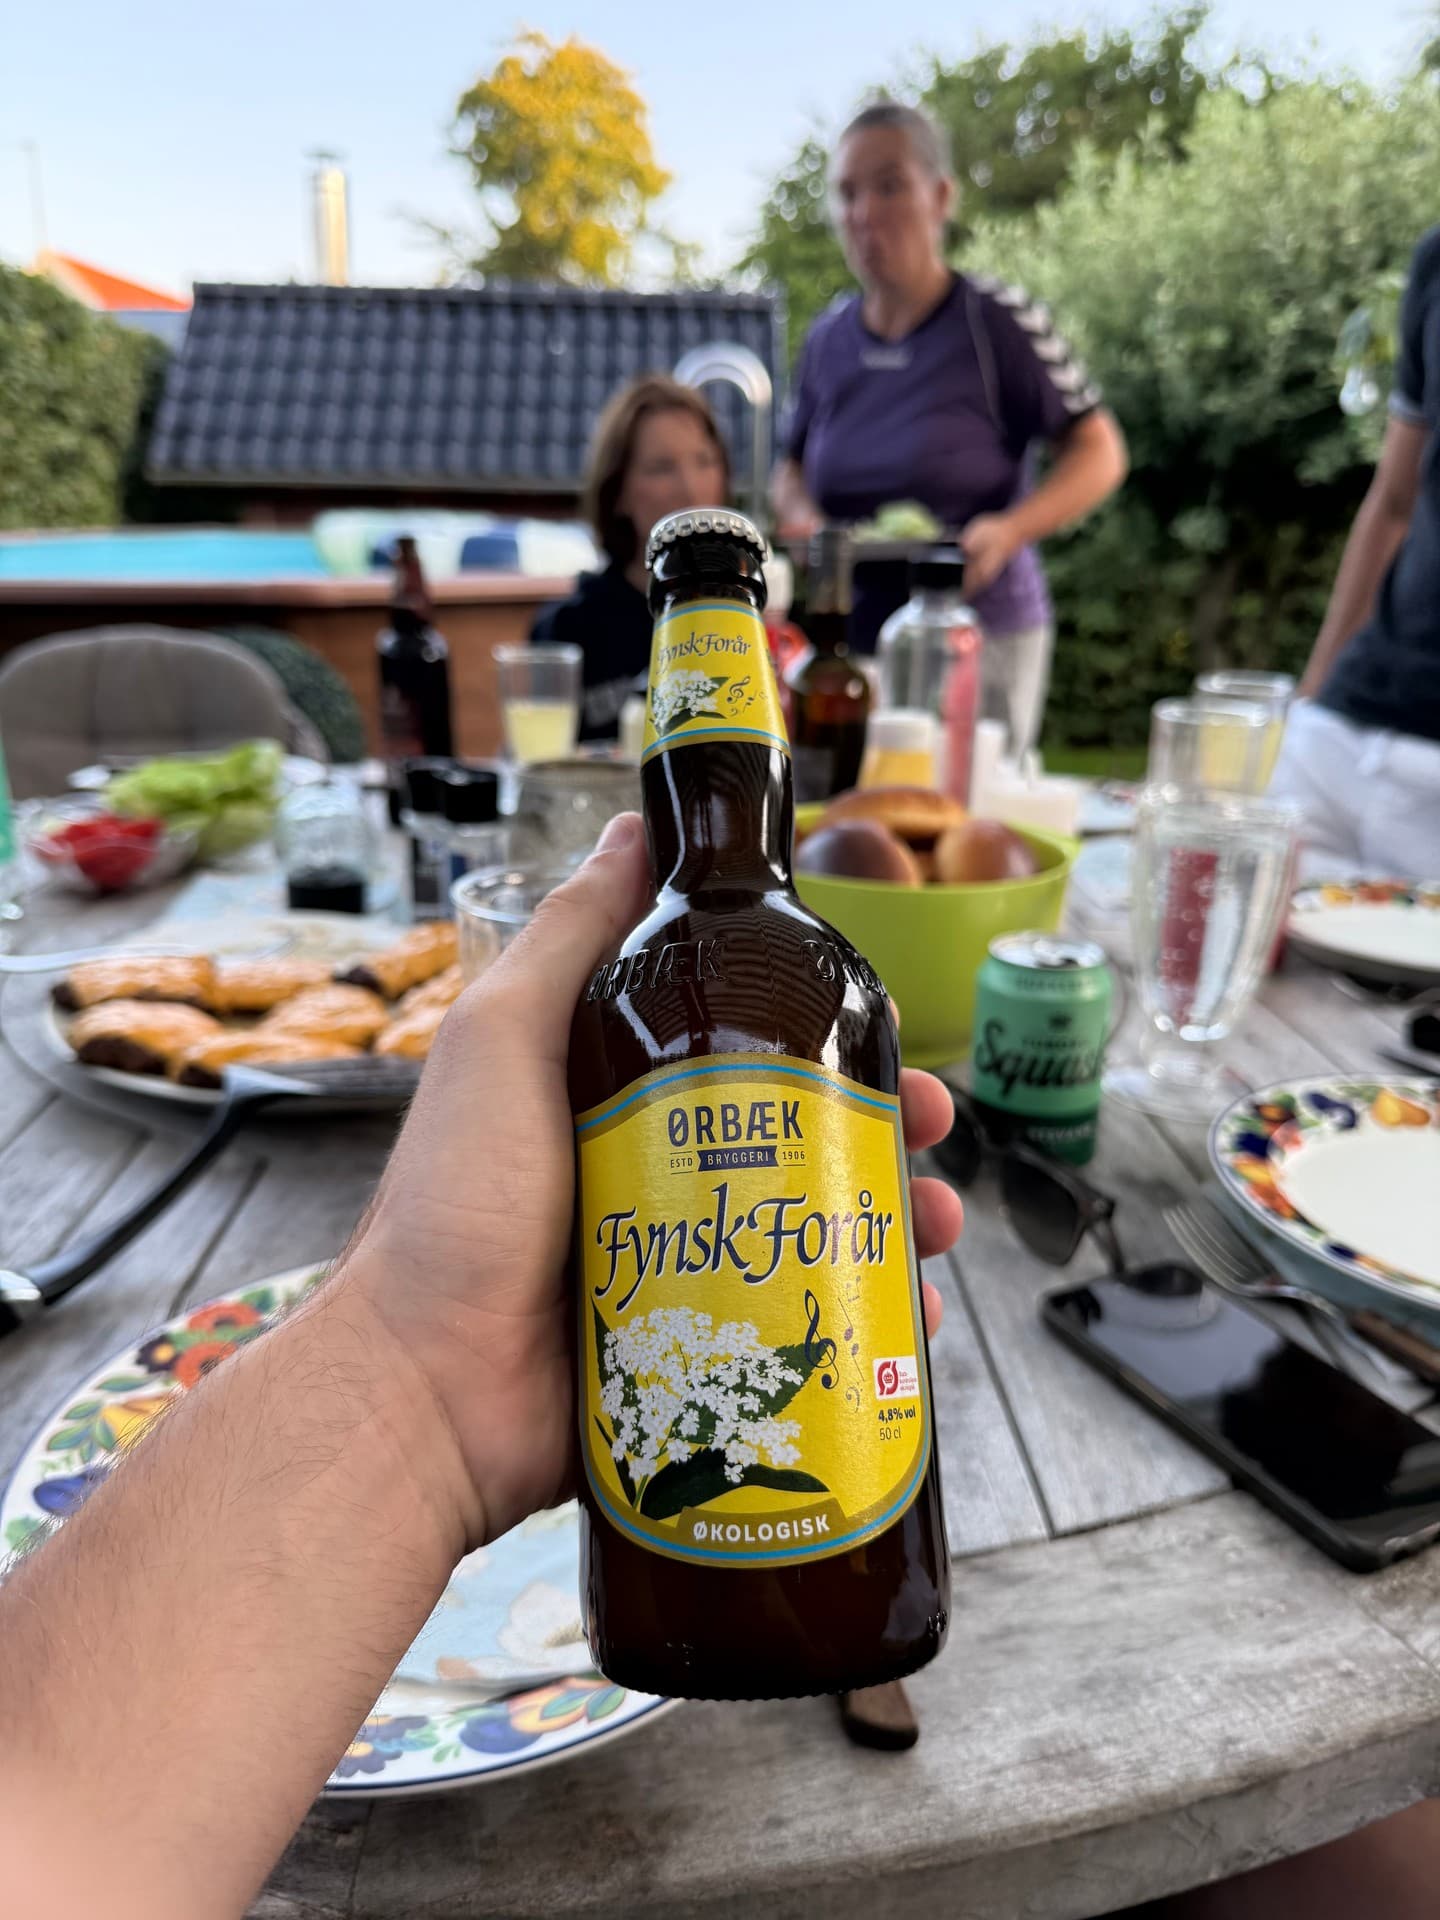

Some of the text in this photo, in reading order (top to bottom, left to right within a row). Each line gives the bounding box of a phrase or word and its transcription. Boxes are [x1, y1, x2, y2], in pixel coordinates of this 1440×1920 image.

[697, 633, 752, 657] Forår
[667, 1100, 805, 1148] ØRBÆK
[670, 1150, 806, 1169] ESTD BRYGGERI 1906
[594, 1181, 893, 1312] Fynsk Forår
[878, 1405, 916, 1423] 4,8% vol
[880, 1426, 902, 1440] 50 cl
[692, 1513, 831, 1543] ØKOLOGISK
